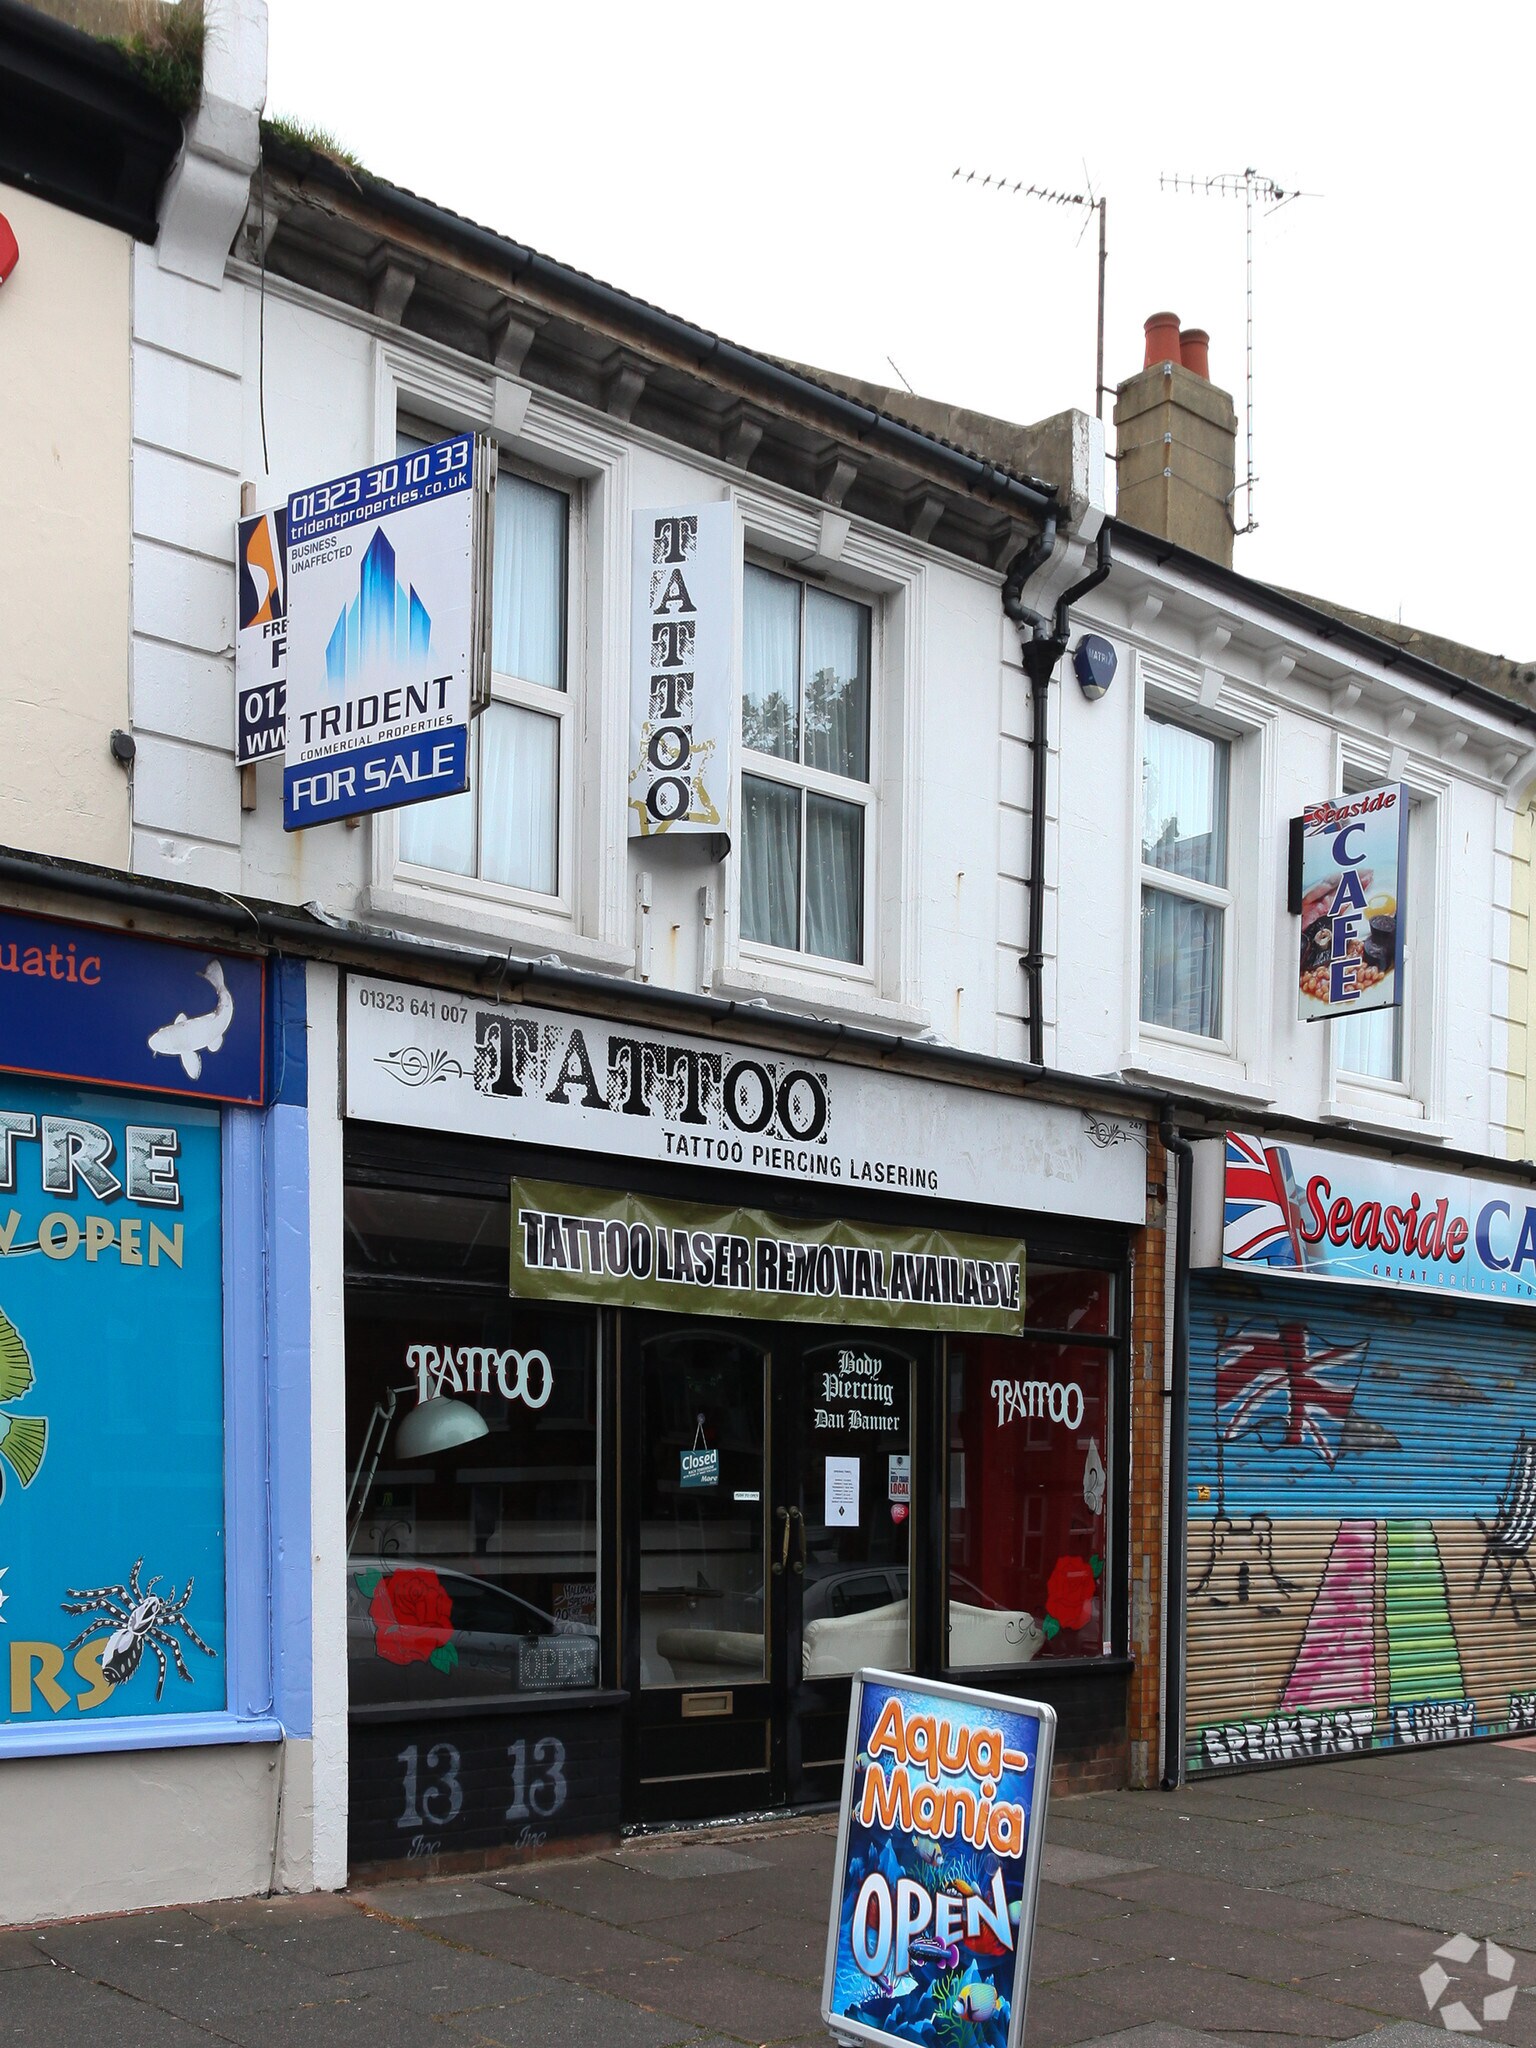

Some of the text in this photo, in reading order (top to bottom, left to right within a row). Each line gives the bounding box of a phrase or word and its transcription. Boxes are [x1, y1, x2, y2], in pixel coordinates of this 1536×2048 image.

[291, 440, 468, 522] 01323 30 10 33
[291, 472, 467, 540] tridentproperties.co.uk
[291, 535, 337, 560] BUSINESS
[291, 545, 352, 574] UNAFFECTED
[646, 515, 699, 824] TATTOO
[1088, 648, 1114, 666] MATRIX
[300, 675, 453, 744] TRIDENT
[300, 714, 453, 761] COMMERCIAL PROPERTIES
[292, 743, 454, 812] FOR SALE
[1310, 791, 1396, 827] Seaside
[1327, 822, 1369, 1005] CAFE
[359, 988, 468, 1025] 01323 641 007
[474, 1011, 832, 1145] TATTOO
[1128, 1121, 1143, 1130] 247
[664, 1132, 938, 1191] TATTOO PIERCING LASERING
[38, 1211, 184, 1269] OPEN
[1300, 1175, 1469, 1265] Seaside
[518, 1208, 1020, 1311] TATTOO LASER REMOVAL AVAILABLE
[1373, 1264, 1427, 1281] GREAT
[1438, 1272, 1507, 1292] BRITISH
[405, 1343, 554, 1409] TATTOO
[821, 1372, 894, 1406] Piercing
[838, 1350, 882, 1380] Body
[814, 1408, 900, 1432] Dan Banner
[990, 1379, 1085, 1430] TATTOO
[682, 1449, 717, 1470] Closed
[890, 1483, 909, 1495] LOCAL
[524, 1647, 594, 1679] OPEN
[867, 1696, 1028, 1783] Aqua-
[397, 1736, 567, 1828] 13 13
[860, 1762, 1025, 1858] Mania
[852, 1867, 1014, 1976] OPEN
